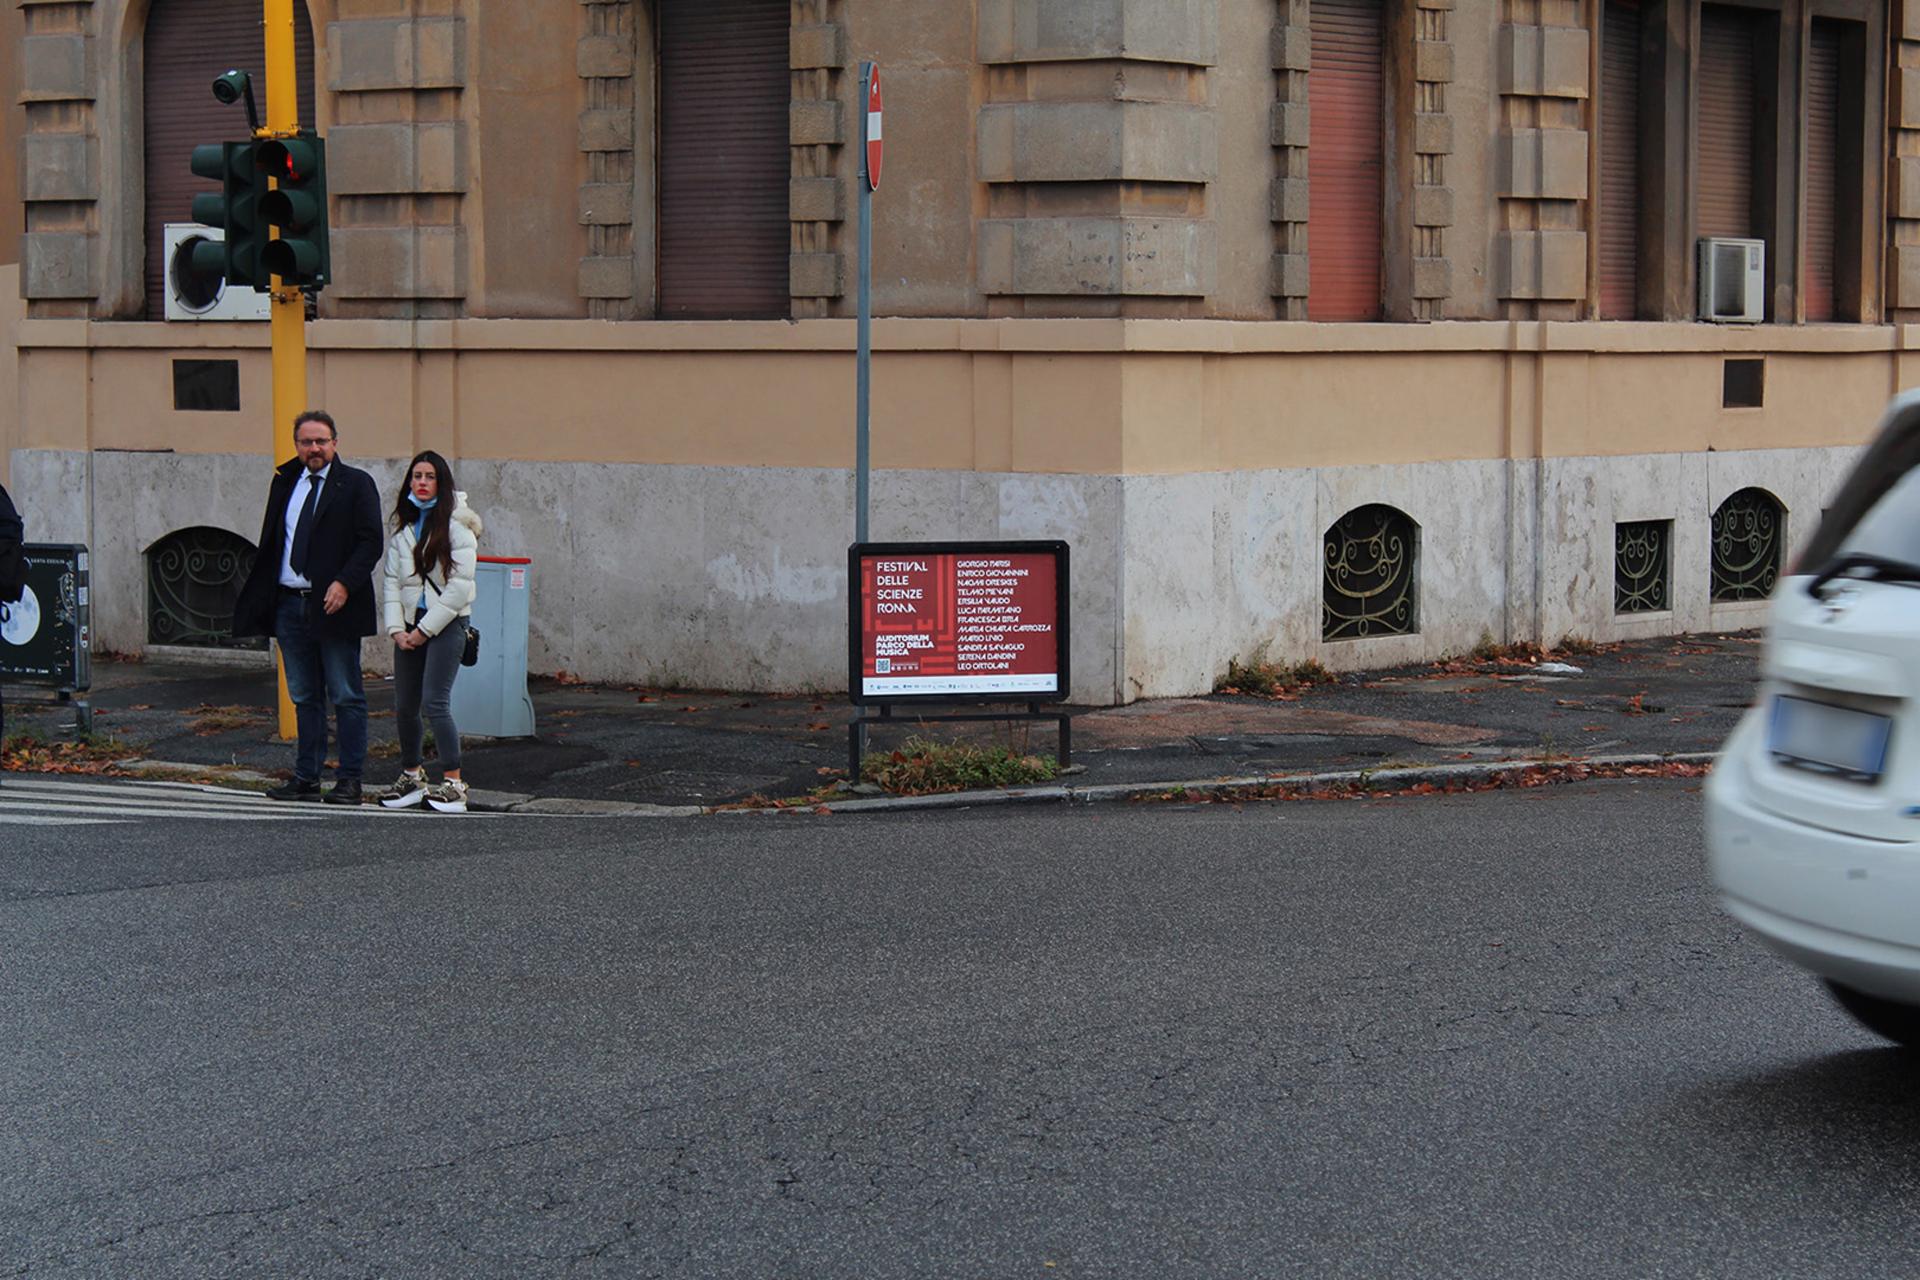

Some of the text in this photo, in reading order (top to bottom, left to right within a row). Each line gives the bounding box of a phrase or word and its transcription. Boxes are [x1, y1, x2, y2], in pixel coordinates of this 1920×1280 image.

[877, 562, 928, 572] FESTIVAL
[957, 560, 988, 568] GIORGIO
[877, 576, 909, 586] DELLE
[877, 589, 923, 599] SCIENZE
[957, 588, 985, 596] TELMO
[877, 603, 917, 613] ROMA
[977, 606, 1022, 614] PARMITANO
[957, 616, 1001, 624] FRANCESCA
[957, 625, 984, 633] MARIA
[876, 634, 929, 642] AUDITORIUM
[876, 641, 905, 649] PARCO
[957, 653, 986, 661] SERENA
[973, 662, 1009, 670] ORTOLANI
